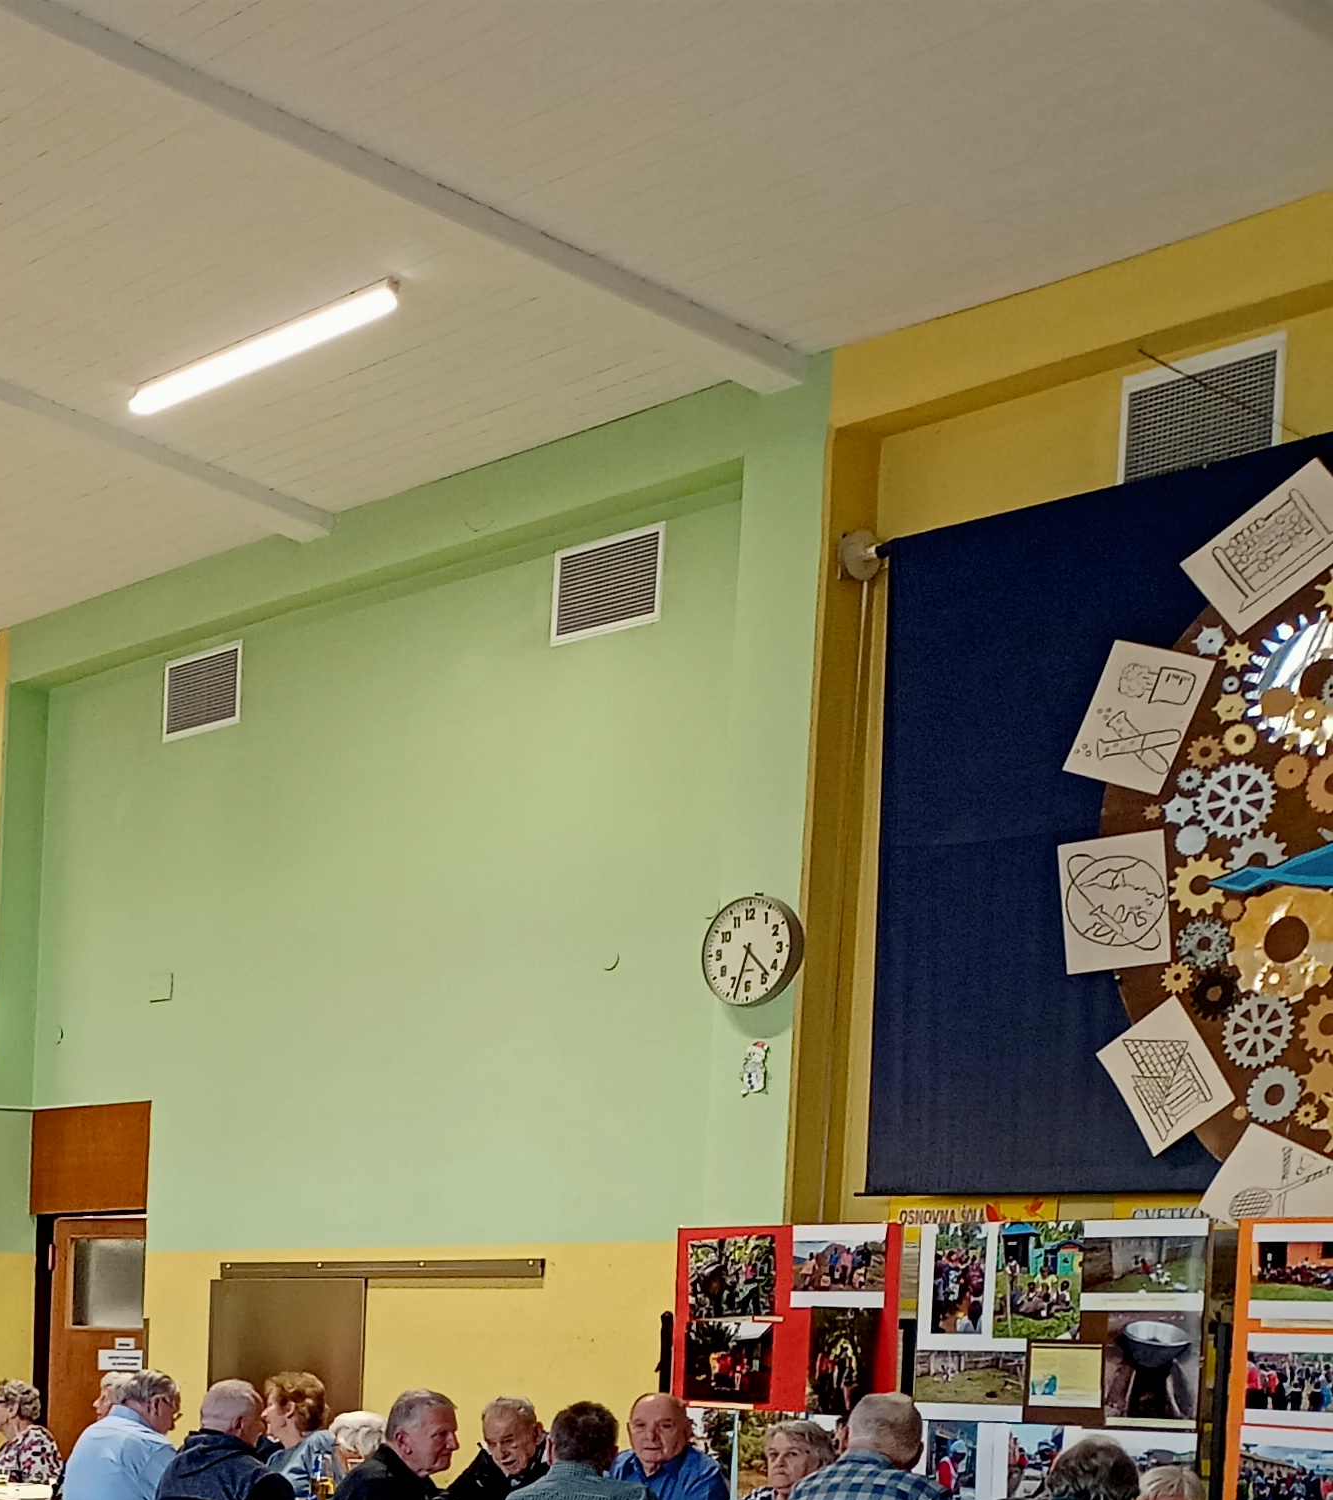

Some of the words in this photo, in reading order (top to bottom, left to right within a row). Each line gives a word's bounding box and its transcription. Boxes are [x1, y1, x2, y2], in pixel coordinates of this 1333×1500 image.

[744, 908, 755, 921] 12
[764, 912, 768, 924] 1
[733, 916, 741, 928] 11
[771, 924, 779, 936] 2
[721, 931, 731, 944] 10
[775, 941, 783, 953] 3
[715, 949, 722, 961] 9
[720, 965, 727, 977] 8
[770, 959, 778, 971] 4
[730, 976, 737, 989] 7
[760, 973, 768, 985] 5
[744, 980, 751, 993] 6
[900, 1209, 956, 1225] OSNOVNA
